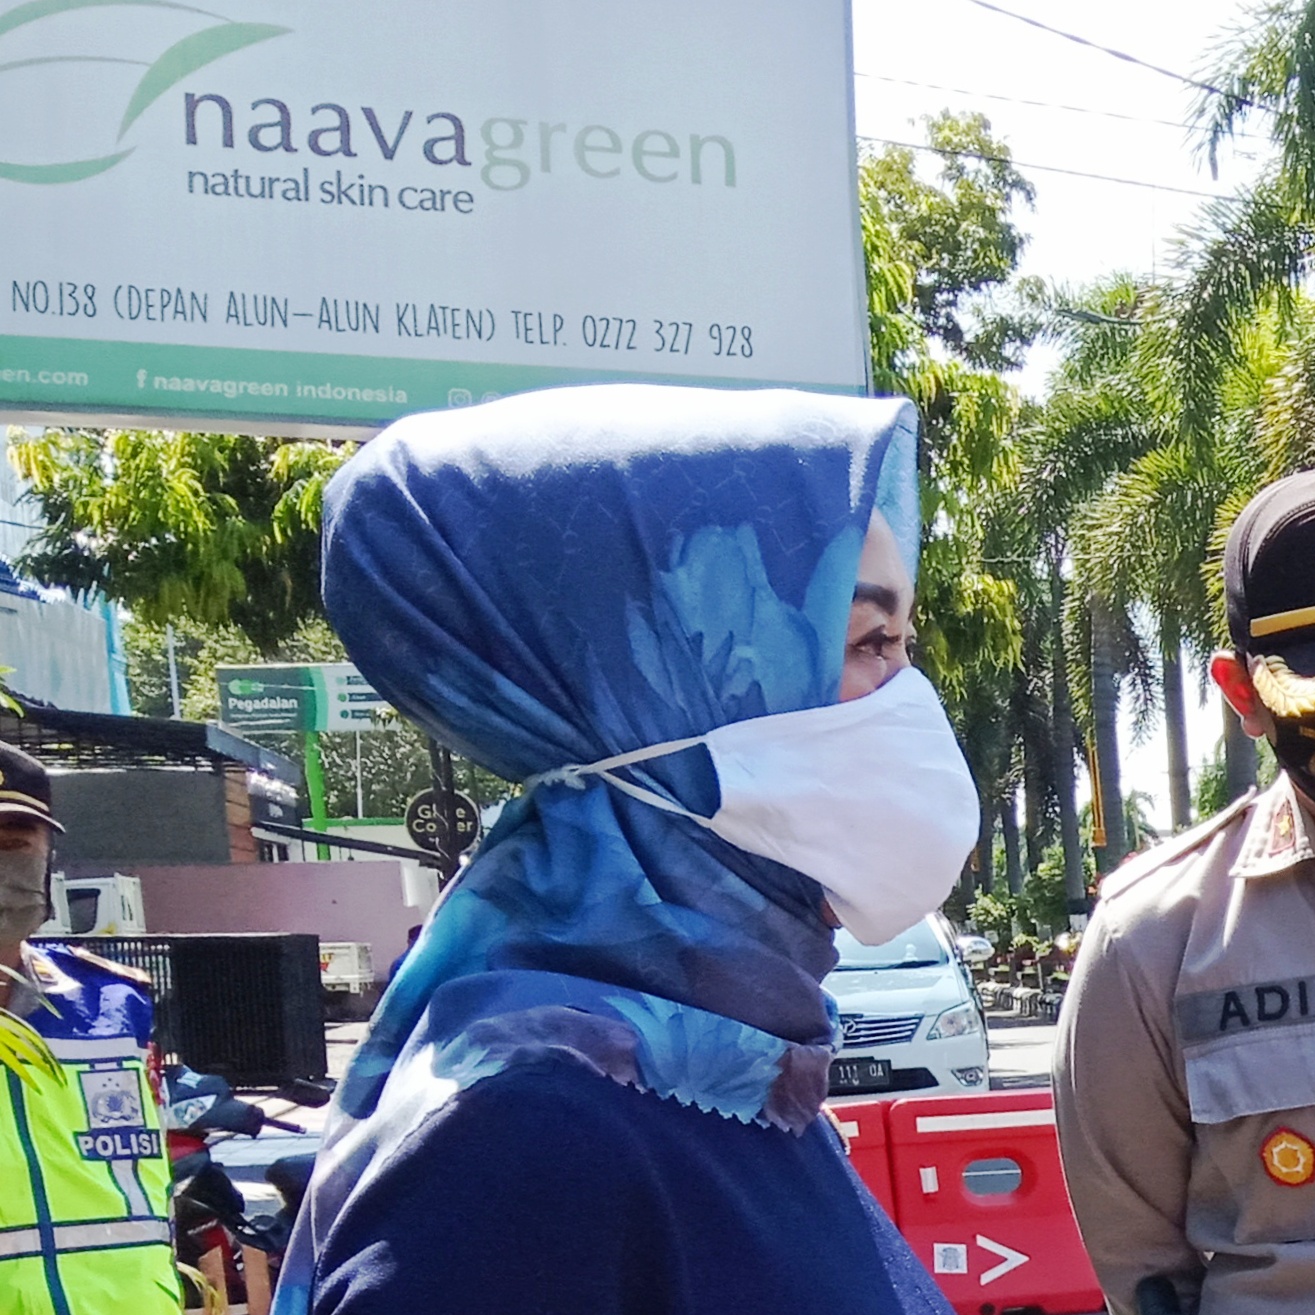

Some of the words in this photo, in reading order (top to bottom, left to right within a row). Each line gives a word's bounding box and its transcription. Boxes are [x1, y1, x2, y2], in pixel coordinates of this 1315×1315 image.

[183, 90, 737, 192] naavagreen
[187, 167, 310, 203] natural
[319, 174, 389, 209] skin
[398, 184, 475, 214] care
[11, 280, 97, 318] NO.138
[114, 284, 208, 324] (DEPAN
[396, 302, 495, 342] KLATEN)
[511, 310, 567, 346] TELP.
[582, 314, 637, 351] 0272
[653, 319, 693, 355] 327
[708, 323, 754, 358] 928
[153, 374, 289, 398] naavagreen
[294, 380, 408, 404] indonesia
[1218, 980, 1309, 1031] ADI
[78, 1132, 160, 1158] POLISI
